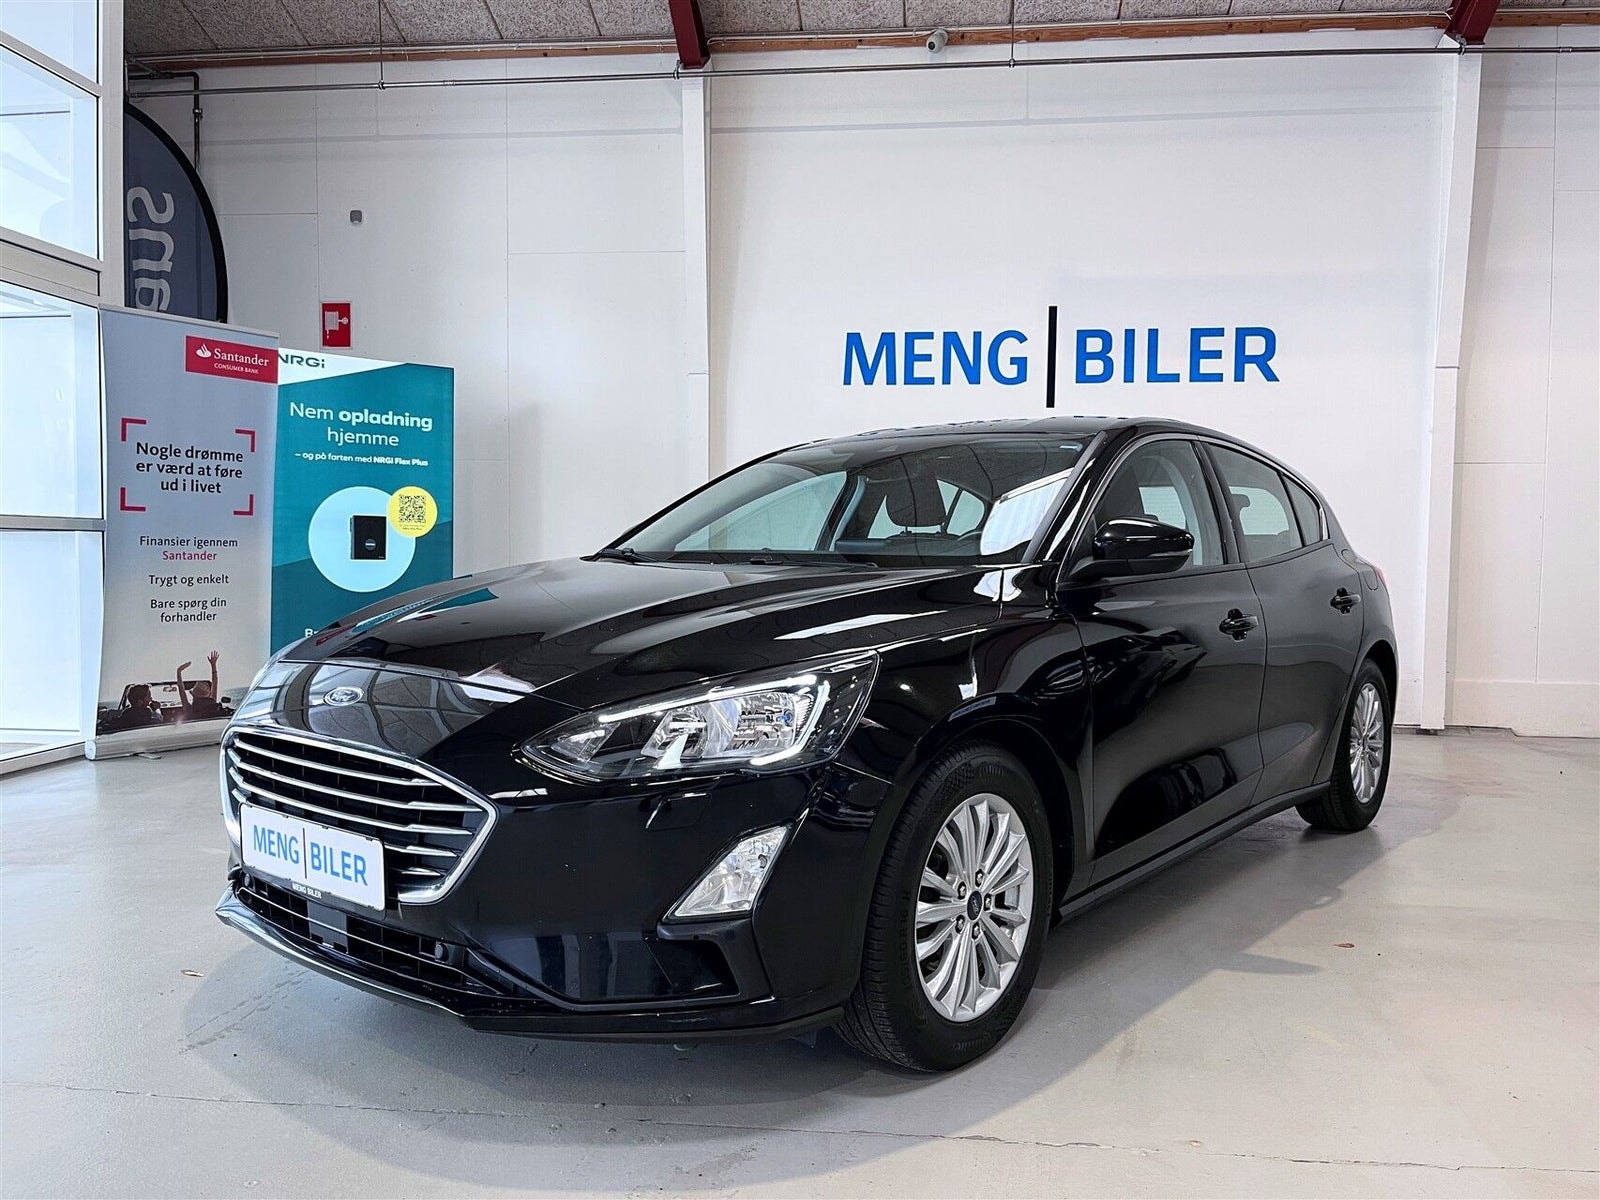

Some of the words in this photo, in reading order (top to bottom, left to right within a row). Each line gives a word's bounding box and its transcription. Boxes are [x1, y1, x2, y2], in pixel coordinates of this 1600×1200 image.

[213, 348, 270, 367] Santander
[843, 330, 1028, 386] MENG
[1075, 326, 1280, 384] BILER
[214, 362, 244, 372] CONSUMER
[290, 402, 334, 420] Nem
[338, 409, 433, 432] opladning
[327, 427, 400, 446] hjemme
[136, 442, 182, 460] Nogle
[185, 445, 244, 463] drømme
[302, 453, 314, 461] og
[315, 452, 326, 461] på
[328, 453, 353, 462] farten
[412, 459, 428, 467] Plus
[136, 461, 153, 472] er
[156, 462, 194, 476] værd
[198, 466, 212, 477] at
[215, 463, 243, 479] føre
[160, 478, 178, 492] ud
[182, 479, 186, 492] i
[190, 479, 222, 494] livet
[140, 536, 190, 547] Finansier
[193, 537, 238, 550] igennem
[162, 550, 217, 561] Santander
[149, 574, 178, 587] Trygt
[181, 576, 194, 587] og
[197, 574, 229, 584] enkelt
[151, 599, 175, 609] Bare
[178, 599, 208, 611] spørg
[211, 597, 227, 607] din
[160, 611, 217, 622] forhandler
[253, 824, 300, 865] MENG
[310, 842, 368, 886] BILER
